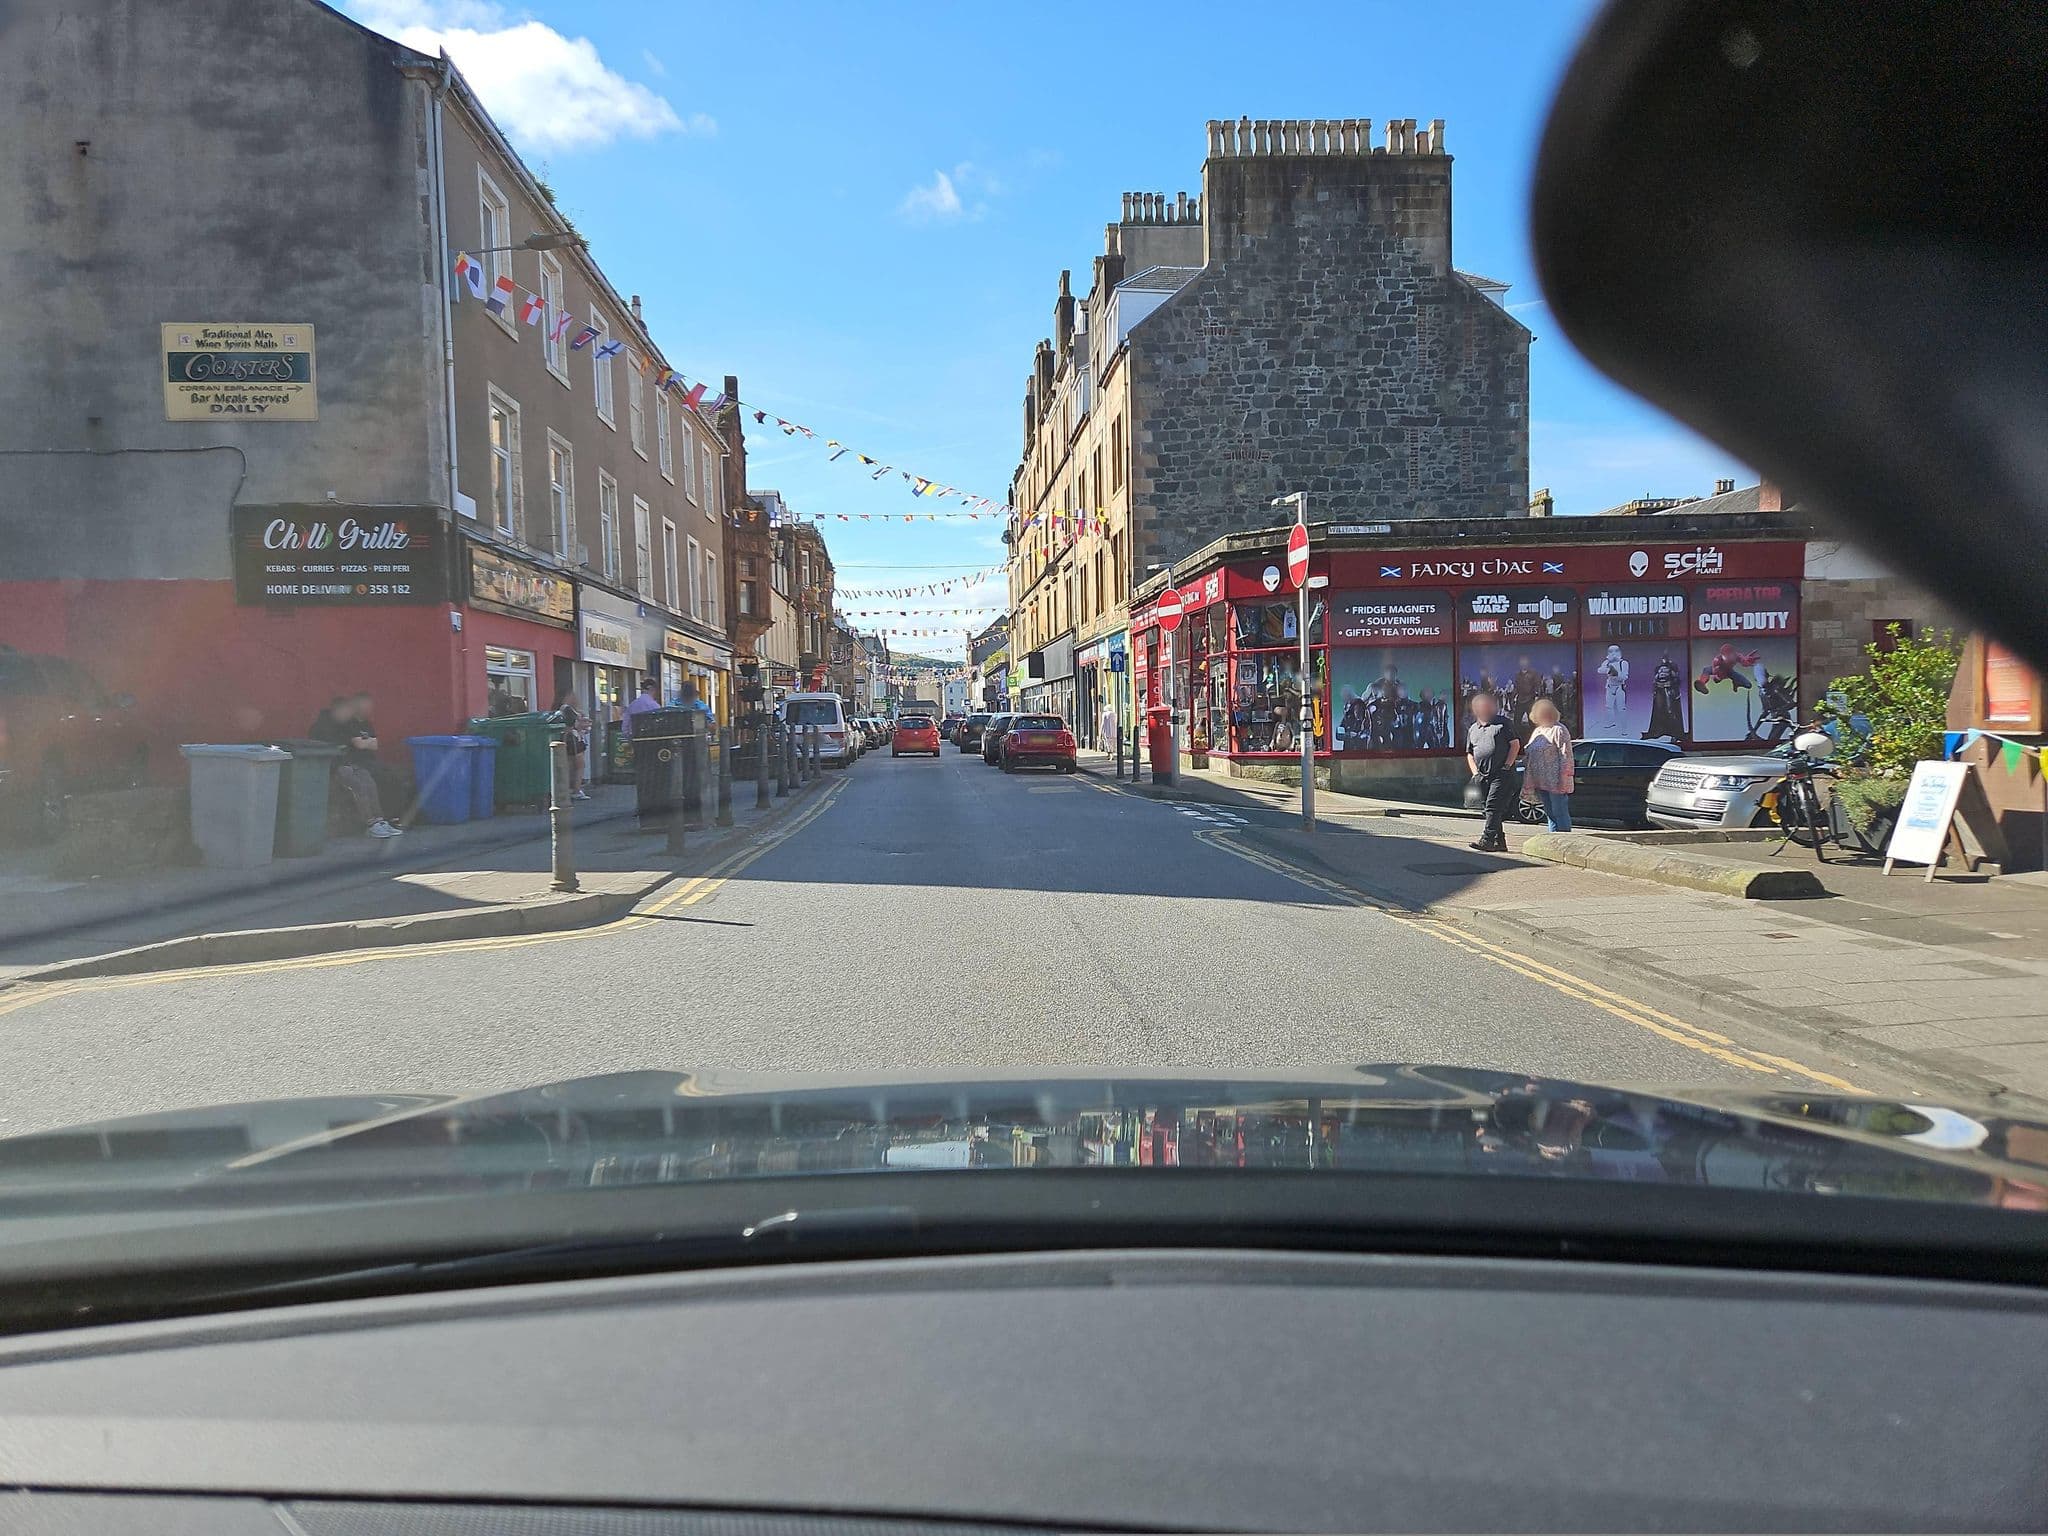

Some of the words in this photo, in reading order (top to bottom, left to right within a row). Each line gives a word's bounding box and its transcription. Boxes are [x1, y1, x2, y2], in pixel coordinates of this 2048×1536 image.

[202, 328, 251, 339] Traditional
[255, 329, 273, 339] Ales
[195, 339, 222, 349] Wines
[224, 339, 251, 350] Spirits
[254, 339, 278, 348] Malts
[190, 393, 211, 404] Bar
[214, 393, 248, 404] Meals
[251, 393, 290, 404] served
[210, 404, 270, 414] DAILY
[338, 518, 410, 550] Grillz
[266, 564, 296, 573] KEBABS
[302, 564, 335, 573] CURRIES
[341, 564, 368, 573] PIZZAS
[373, 564, 391, 573] PERI
[392, 564, 410, 573] PERI
[1695, 567, 1722, 575] PLANET
[267, 585, 299, 594] HOME
[369, 585, 389, 594] 358
[392, 585, 411, 594] 182
[1472, 595, 1510, 604] STAR
[1352, 605, 1386, 615] FRIDGE
[1389, 604, 1436, 614] MAGNETS
[1472, 604, 1510, 613] WARS
[1588, 597, 1648, 615] WALKING
[1649, 596, 1684, 613] DEAD
[1367, 616, 1421, 626] SOUVENIRS
[1505, 617, 1530, 627] GAME
[1699, 613, 1739, 631] CALL
[1743, 611, 1789, 630] DUTY
[1345, 628, 1371, 637] GIFTS
[1381, 628, 1399, 636] TEA
[1401, 627, 1440, 636] TOWELS
[1469, 621, 1498, 633] MARVEL
[1503, 627, 1538, 636] THRONES
